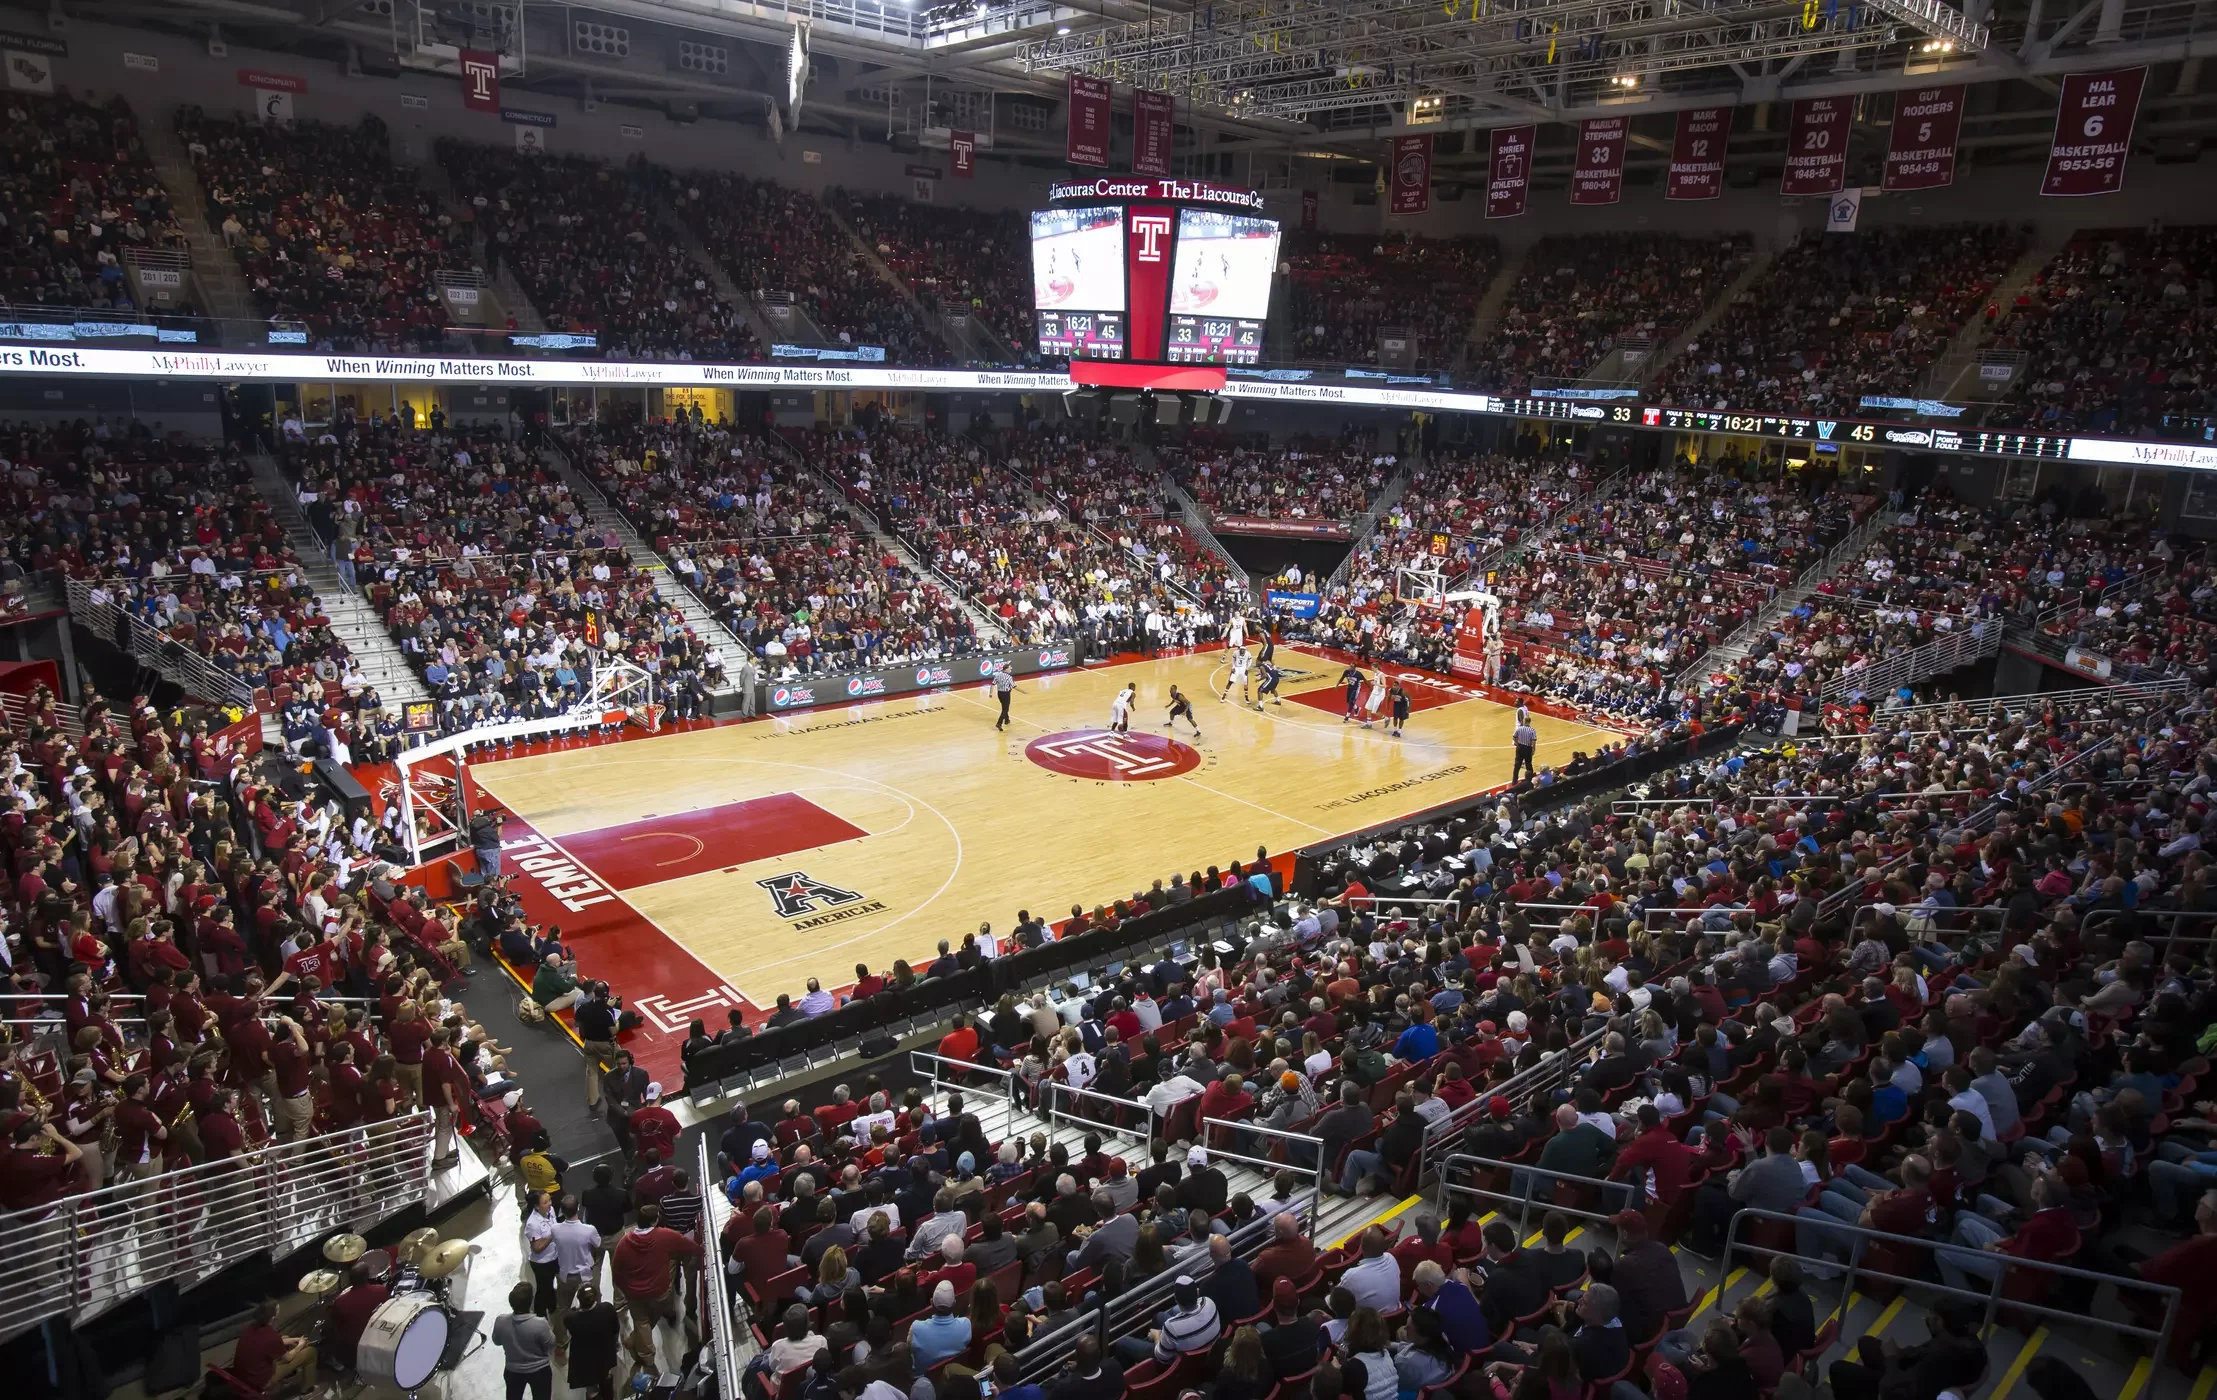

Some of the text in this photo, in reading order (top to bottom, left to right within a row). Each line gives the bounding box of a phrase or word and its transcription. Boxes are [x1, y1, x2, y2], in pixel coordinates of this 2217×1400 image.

[249, 74, 297, 88] CINCINNATI
[2088, 80, 2115, 93] HAL
[1918, 90, 1941, 102] GUY
[2081, 94, 2117, 108] LEAR
[1812, 100, 1833, 111] BILL
[1903, 101, 1954, 116] RODGERS
[505, 111, 553, 124] CONNECTICUT
[1692, 110, 1717, 121] MARK
[1804, 112, 1837, 124] MLKVY
[1589, 119, 1621, 130] MARILYN
[1688, 123, 1718, 133] MACON
[2083, 115, 2105, 137] 6
[1585, 130, 1623, 141] STEPHENS
[1918, 122, 1932, 142] 5
[1508, 135, 1518, 143] AL
[1804, 130, 1830, 149] 20
[1401, 143, 1423, 151] CHANEY
[1498, 144, 1525, 155] SHRIER
[1691, 140, 1709, 157] 12
[2052, 141, 2126, 157] BASKETBALL
[1072, 152, 1104, 164] BASKETBALL
[1591, 146, 1610, 163] 33
[1788, 153, 1844, 166] BASKETBALL
[1889, 147, 1953, 161] BASKETBALL
[1671, 161, 1722, 173] BASKETBALL
[1899, 162, 1939, 175] 1954-58
[2058, 157, 2116, 171] 1953-56
[1575, 168, 1620, 179] BASKETBALL
[1794, 167, 1831, 179] 1948-52
[1491, 179, 1525, 190] ATHLETICS
[1581, 180, 1611, 190] 1980-84
[1680, 175, 1711, 185] 1987-91
[1052, 179, 1250, 206] Liacouras Center The Liacouras
[163, 273, 178, 283] 202
[1045, 323, 1058, 336] 33
[1066, 316, 1092, 330] 16:21
[1203, 322, 1231, 337] 16:21
[1101, 325, 1116, 339] 45
[1177, 328, 1192, 342] 33
[1240, 332, 1254, 345] 45
[30, 350, 86, 367] Most.
[152, 355, 269, 374] MyPhillyLawyer
[327, 359, 535, 377] When Winning Matters Most.
[703, 367, 853, 382] When Winning Matters Most.
[977, 374, 1001, 384] When
[1003, 375, 1036, 387] Winning
[1038, 376, 1069, 386] Matters
[1238, 382, 1346, 399] Winning Matters Most.
[1613, 407, 1631, 422] 33
[1669, 417, 1718, 430] 2 3 2
[1723, 416, 1763, 432] 16:21
[1791, 419, 1810, 427] FOULS
[1778, 426, 1804, 437] 4 2
[1851, 425, 1874, 441] 45
[1935, 442, 1959, 450] FOULS
[1936, 436, 1963, 445] POINTS
[2132, 445, 2217, 464] MyPhillyLaw
[1432, 543, 1446, 554] 27
[1289, 598, 1315, 606] SPORTS
[587, 623, 597, 646] 27
[1052, 652, 1069, 662] MAX
[930, 669, 951, 681] MAX
[863, 679, 885, 690] MAX
[1398, 673, 1490, 697] OWLS
[790, 689, 814, 701] MAX
[412, 714, 428, 727] 27
[753, 705, 948, 742] THE LIACOURAS CENTER
[1313, 765, 1473, 812] THE LIACOURAS CENTER
[500, 834, 616, 913] TEMPLE
[792, 901, 888, 931] AMERICAN
[301, 957, 320, 974] 13
[1081, 1061, 1090, 1076] 4
[526, 1161, 543, 1171] CSC
